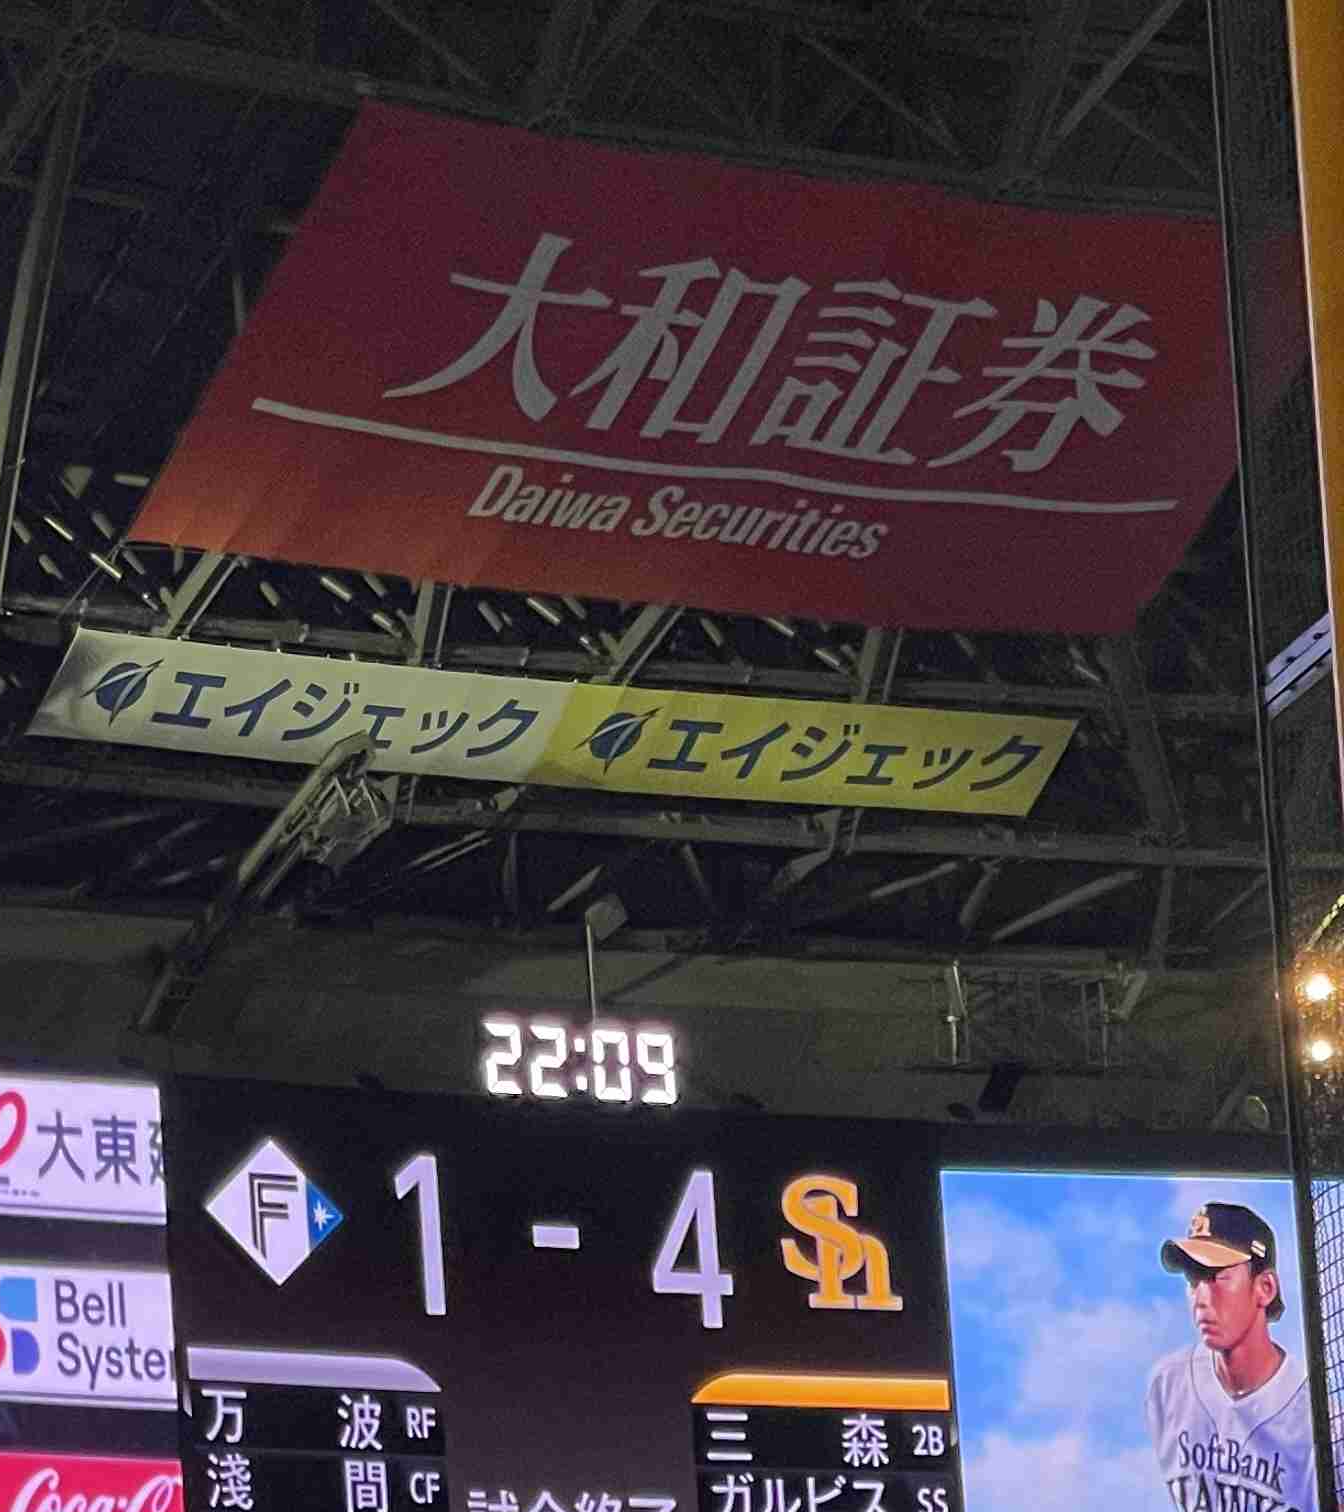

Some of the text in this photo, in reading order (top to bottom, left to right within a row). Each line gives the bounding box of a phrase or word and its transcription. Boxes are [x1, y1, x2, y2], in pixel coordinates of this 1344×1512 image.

[383, 231, 1162, 475] 大和証券
[468, 465, 889, 562] Daiwa Securities
[151, 670, 541, 759] エイジェック
[645, 718, 1051, 792] エイジェック
[484, 1022, 678, 1105] 22:09
[395, 1154, 447, 1316] 1
[653, 1170, 734, 1329] 4
[55, 1279, 127, 1327] Bell
[57, 1333, 176, 1390] Syste
[406, 1407, 437, 1439] RF
[912, 1424, 945, 1457] 2B
[410, 1472, 441, 1504] CF
[1177, 1431, 1286, 1494] SoftBank
